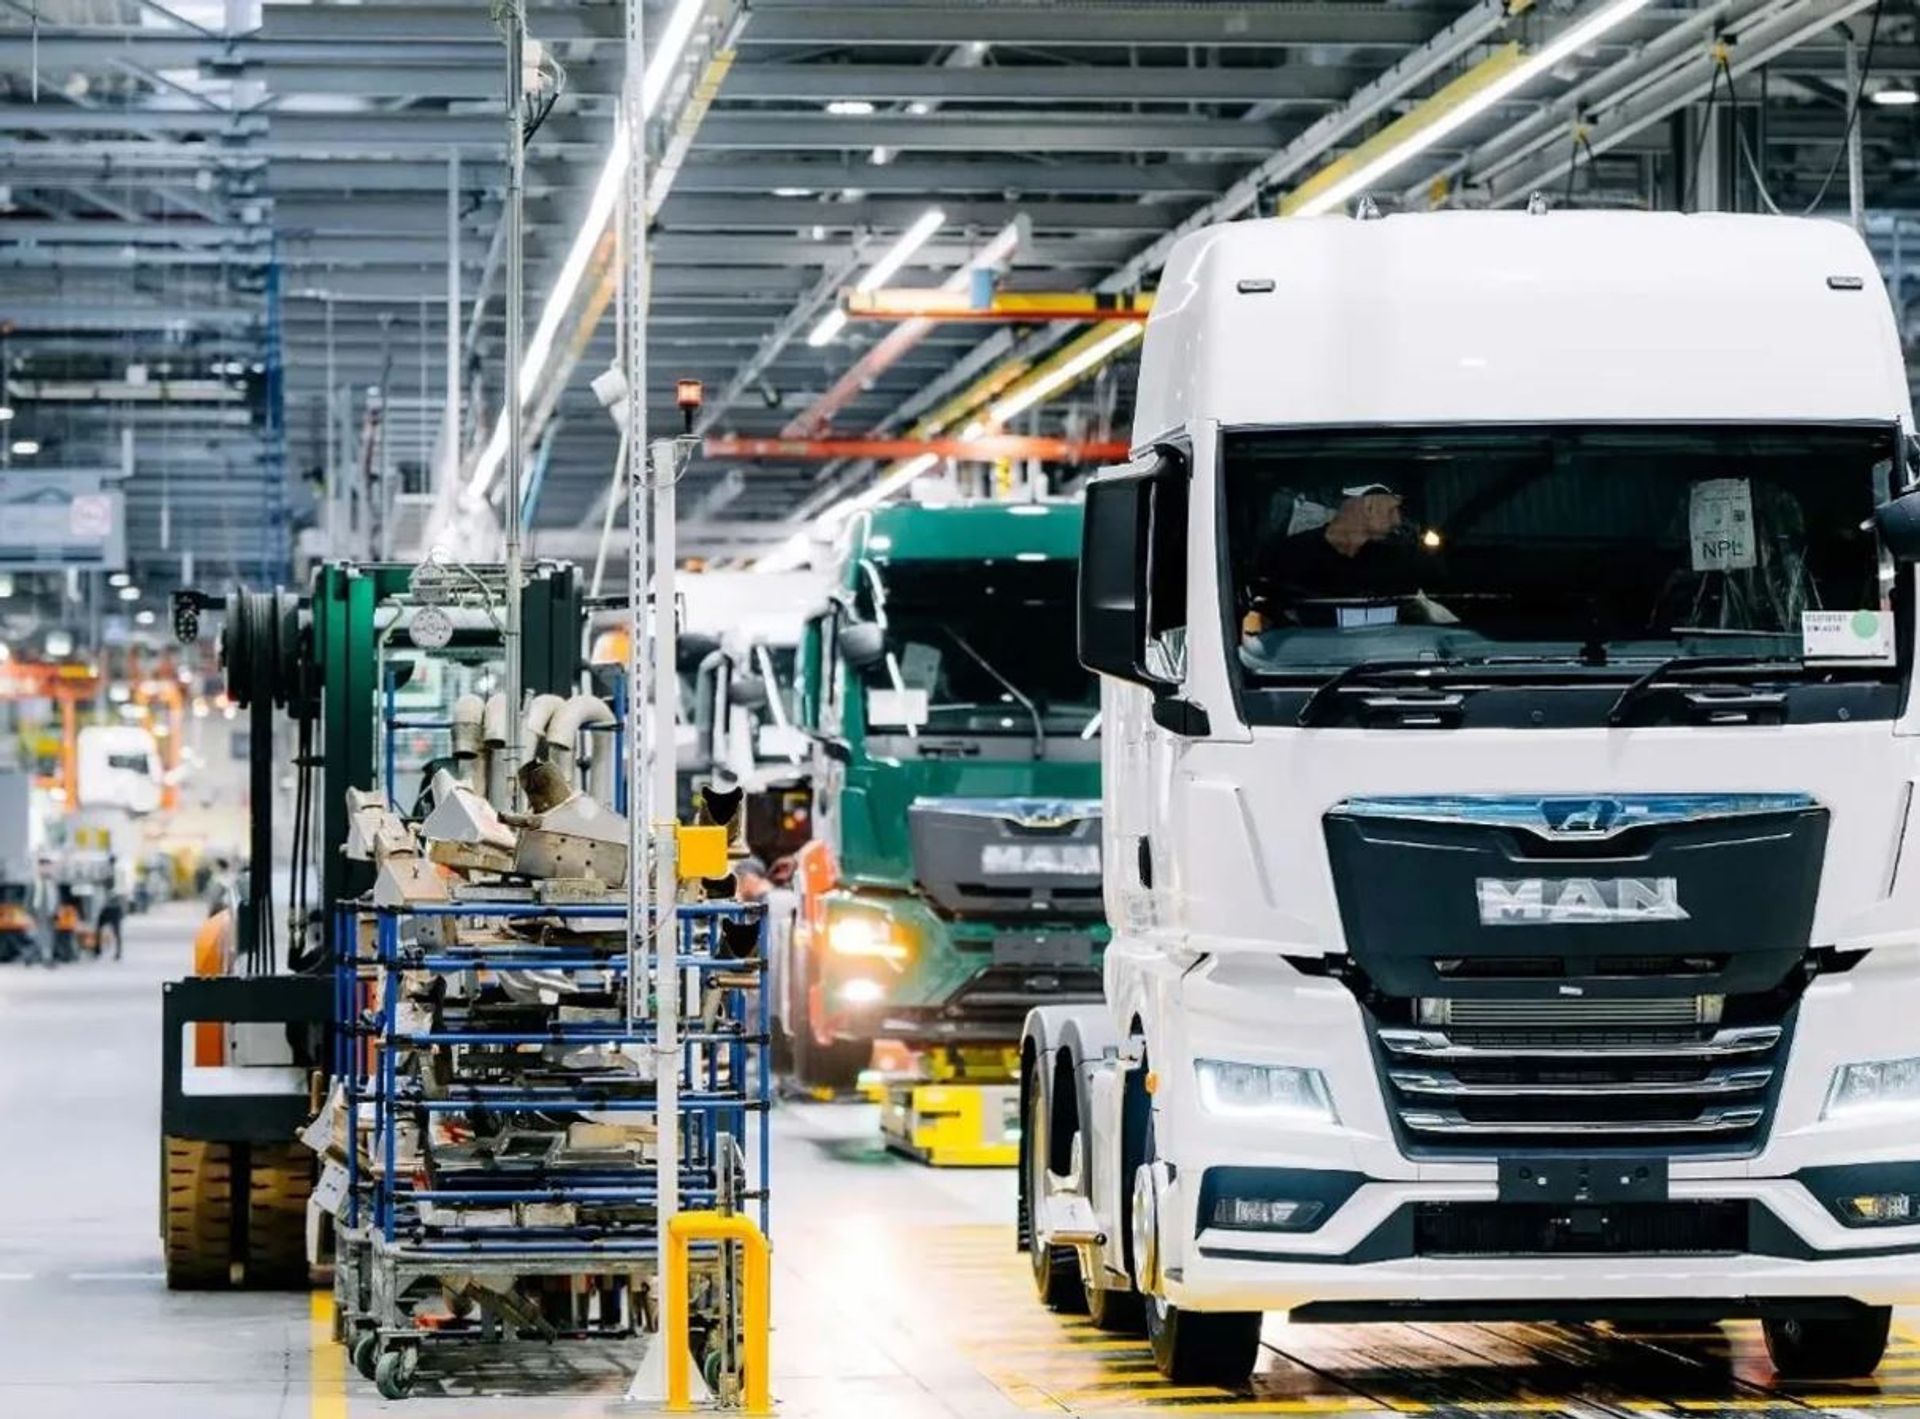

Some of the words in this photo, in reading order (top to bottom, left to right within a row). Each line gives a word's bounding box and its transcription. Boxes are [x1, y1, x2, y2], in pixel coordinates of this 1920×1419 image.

[1702, 540, 1744, 560] NPL
[982, 845, 1100, 874] MAN
[1479, 877, 1679, 922] MAN
